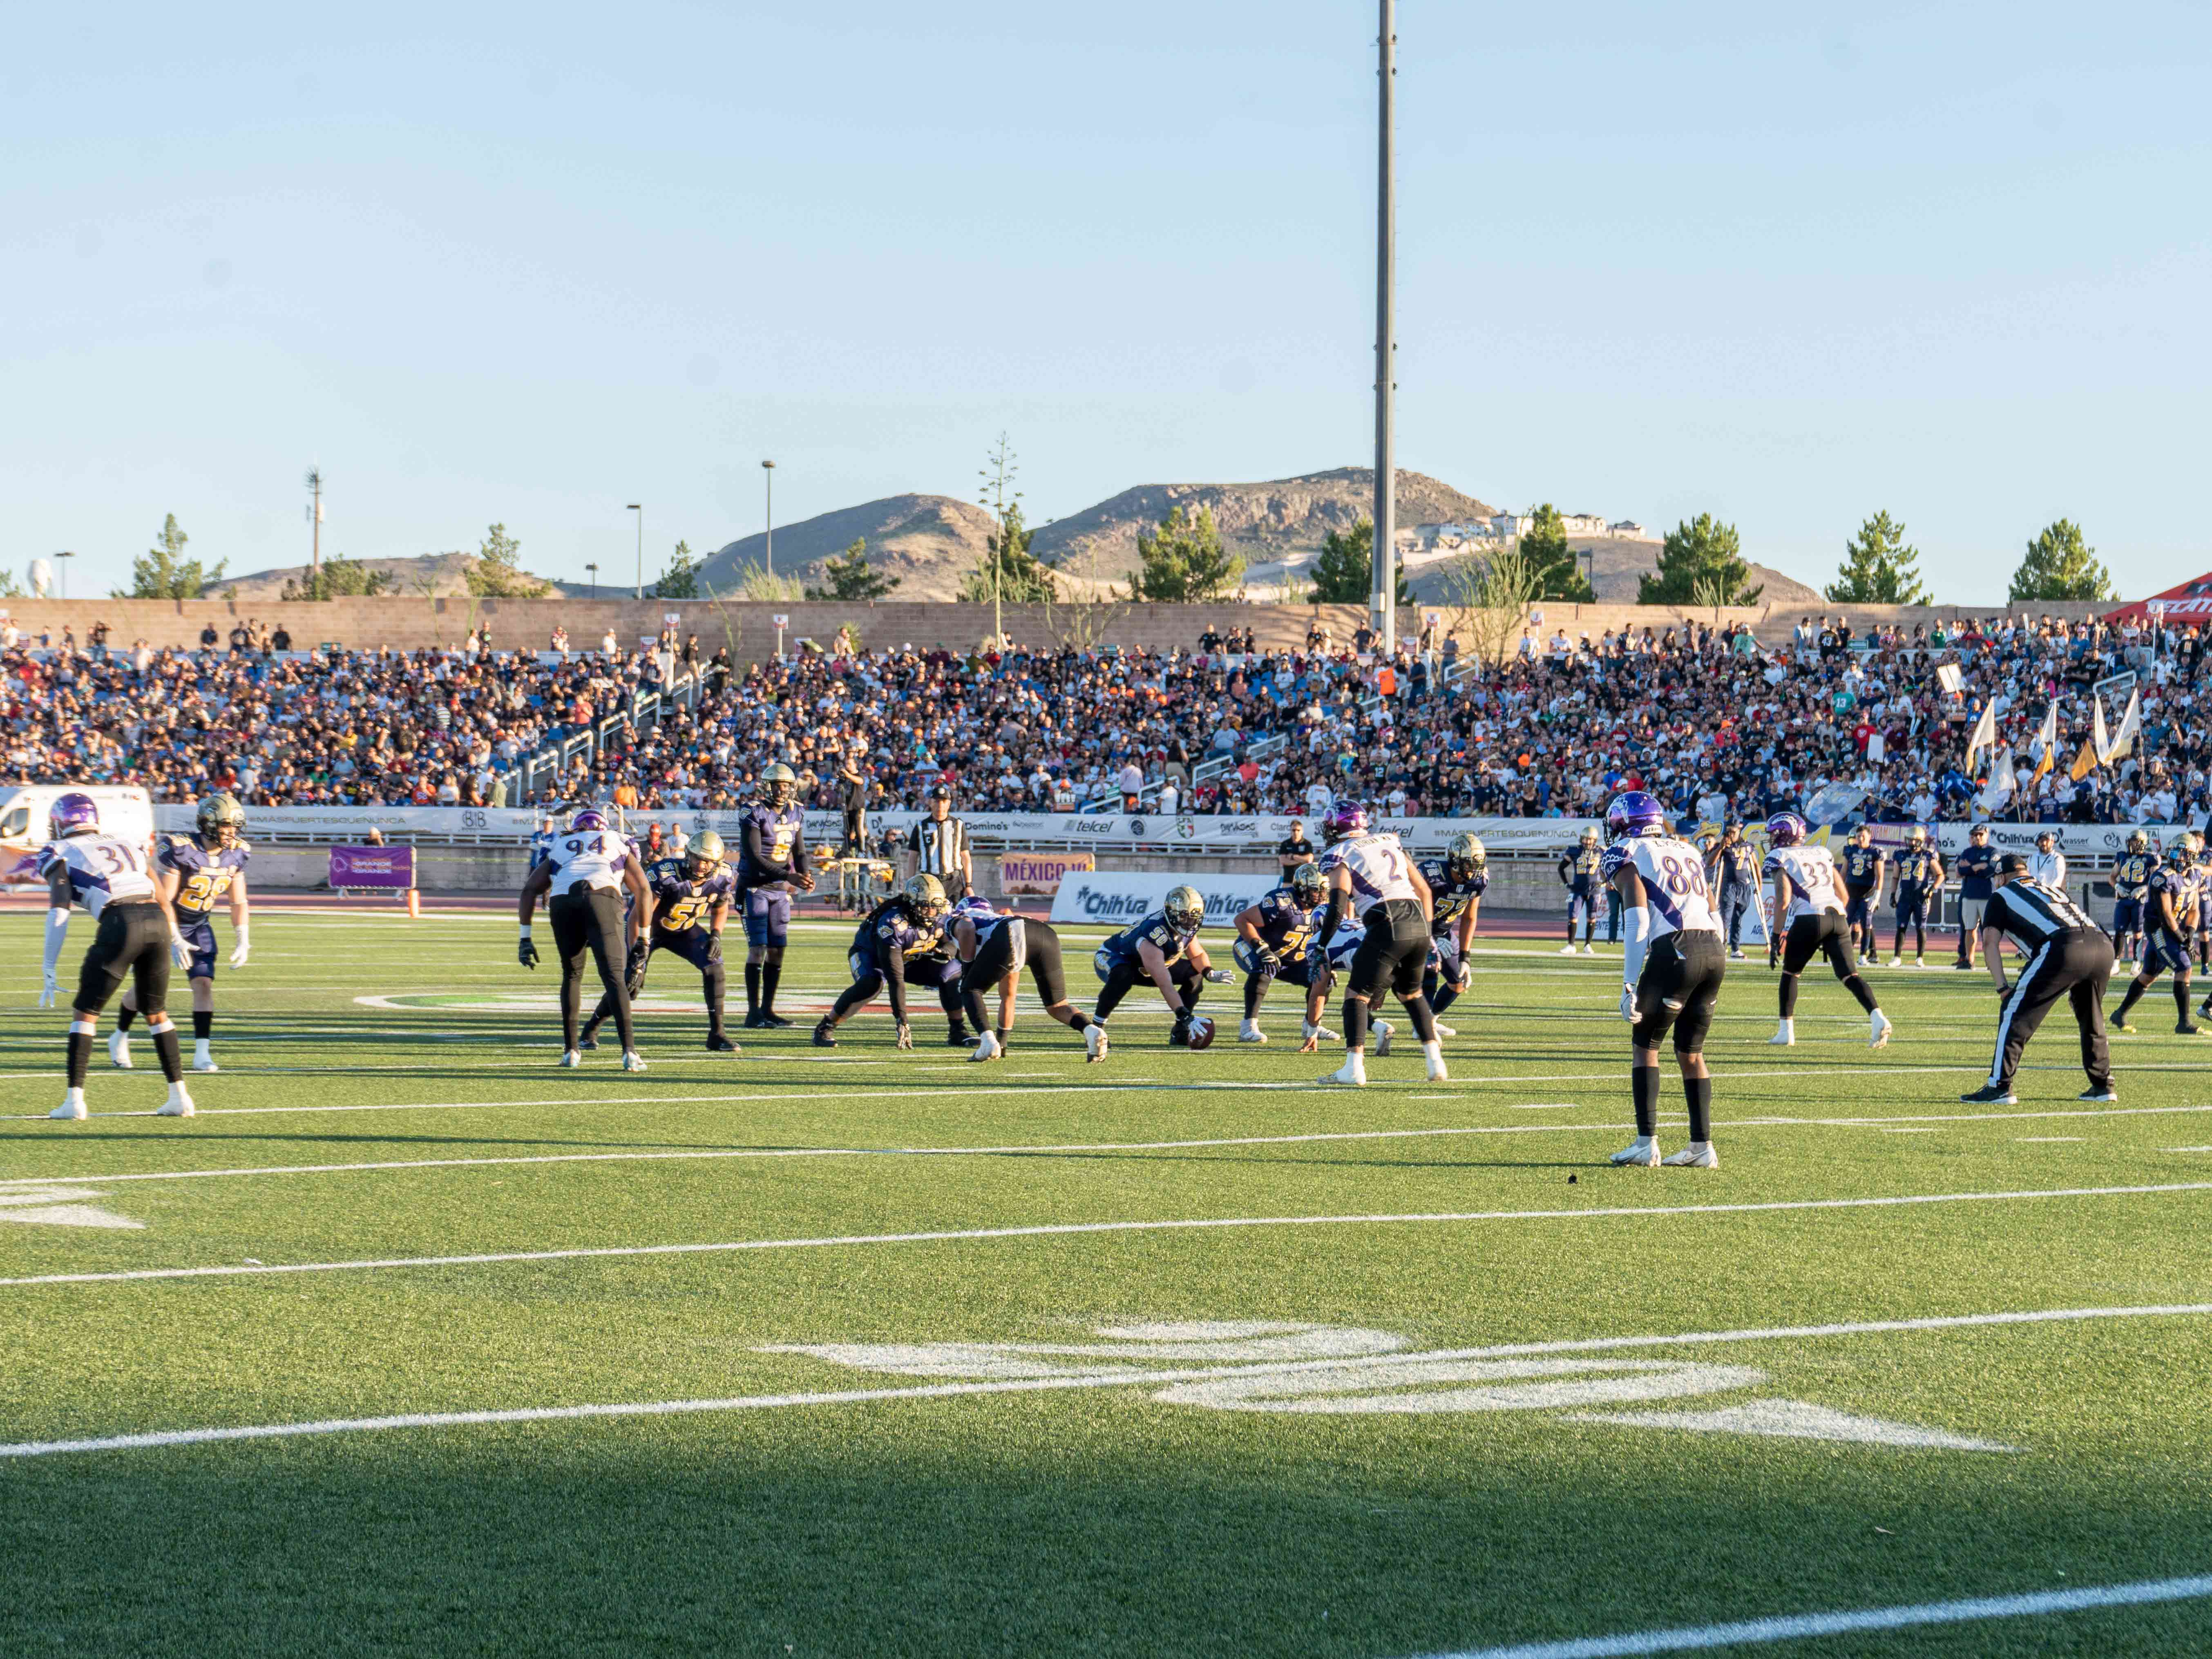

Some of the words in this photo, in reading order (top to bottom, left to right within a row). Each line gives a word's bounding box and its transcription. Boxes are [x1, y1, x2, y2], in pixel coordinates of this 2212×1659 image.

[1836, 698, 1846, 708] 13
[1375, 767, 1384, 778] 12
[965, 821, 1008, 831] Domino's
[1077, 821, 1114, 833] telcel
[565, 835, 607, 856] 94
[96, 844, 138, 874] 31
[1005, 858, 1066, 881] MÉXICO
[1381, 849, 1402, 881] 2
[1852, 858, 1864, 876] 3
[1662, 856, 1705, 896] 88
[1803, 862, 1831, 888] 33
[1901, 860, 1926, 881] 24
[2120, 862, 2145, 883] 42
[660, 903, 709, 932] 51
[1149, 926, 1168, 946] 50
